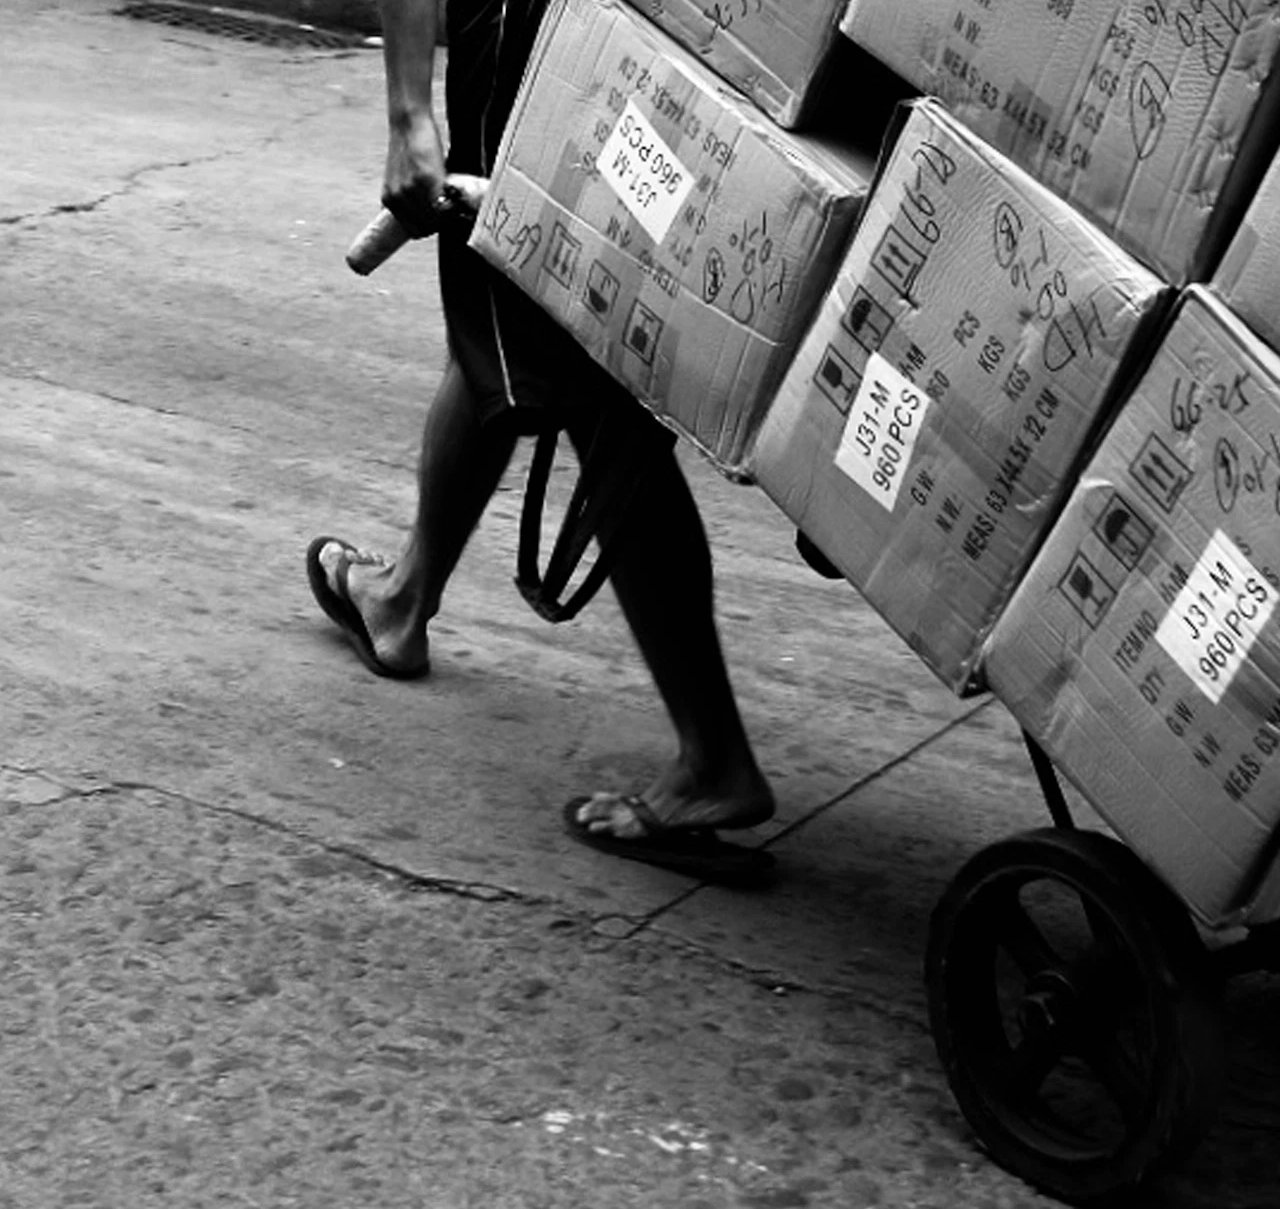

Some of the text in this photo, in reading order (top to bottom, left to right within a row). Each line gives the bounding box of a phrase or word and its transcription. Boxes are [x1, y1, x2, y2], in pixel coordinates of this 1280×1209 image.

[612, 149, 657, 208] J31-M
[619, 114, 683, 194] 960 PCS
[953, 308, 982, 349] PCS
[977, 334, 1006, 375] KGS
[854, 379, 892, 458] J31-M
[1002, 362, 1032, 404] KGS
[871, 388, 921, 492] 960 PCS
[985, 488, 1008, 514] 63
[1035, 386, 1062, 420] CM
[1182, 560, 1235, 641] J31-M
[1198, 630, 1237, 682] 960
[1225, 577, 1269, 639] PCS
